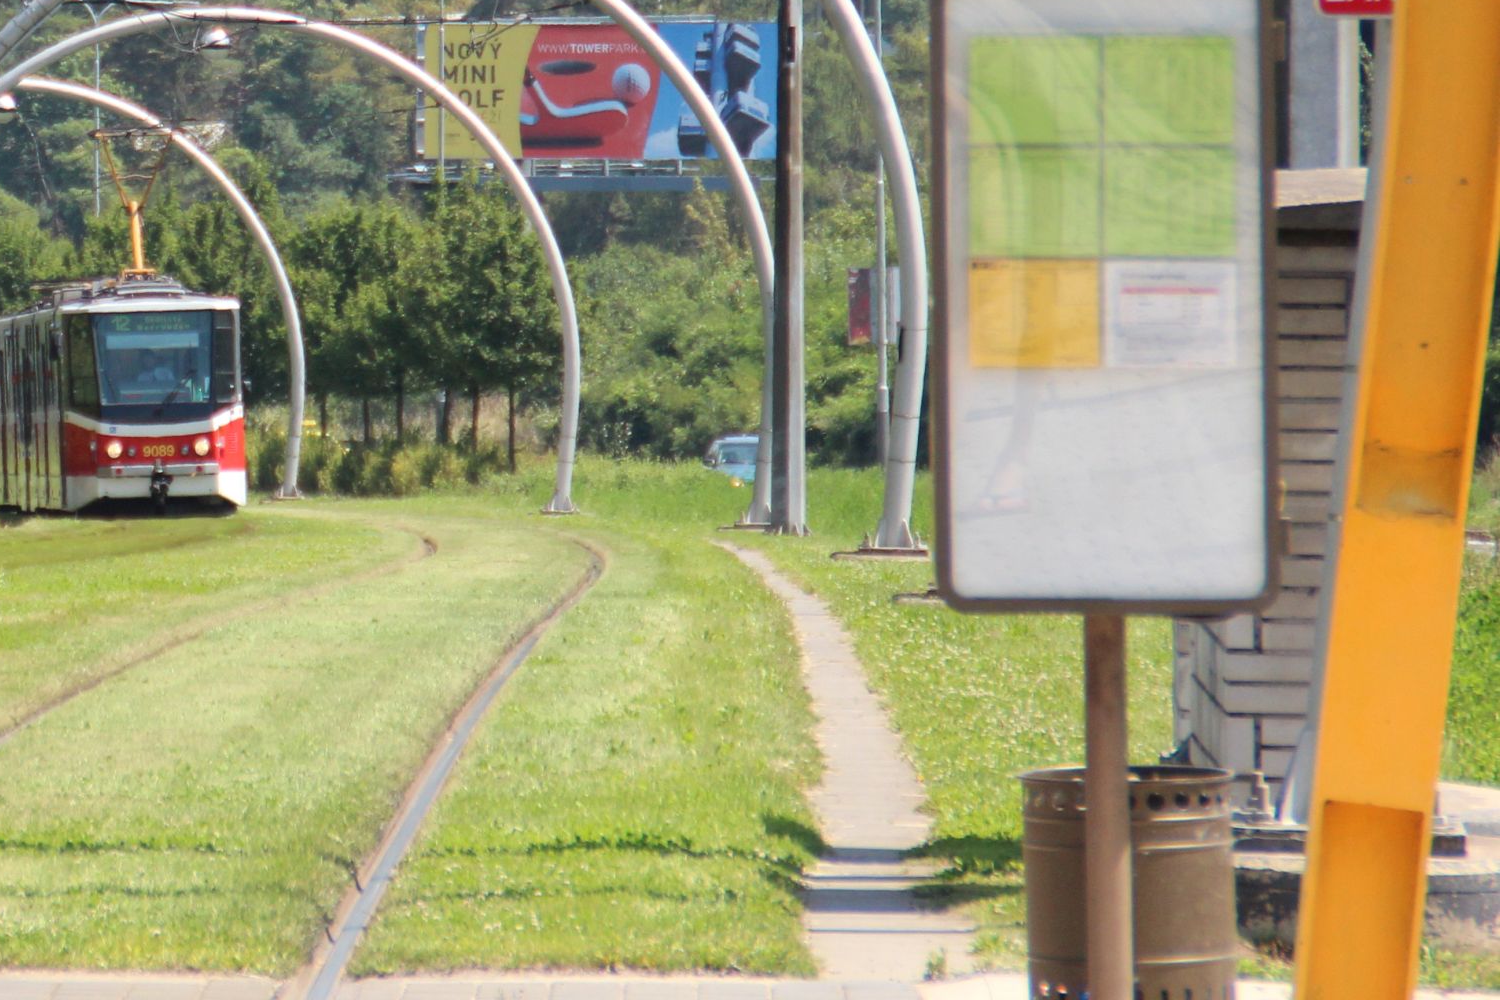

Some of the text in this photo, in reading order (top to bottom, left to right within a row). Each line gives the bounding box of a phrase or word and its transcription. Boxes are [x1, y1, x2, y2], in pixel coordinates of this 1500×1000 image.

[443, 65, 496, 84] MINI
[458, 89, 505, 108] OLF
[111, 314, 131, 331] 12
